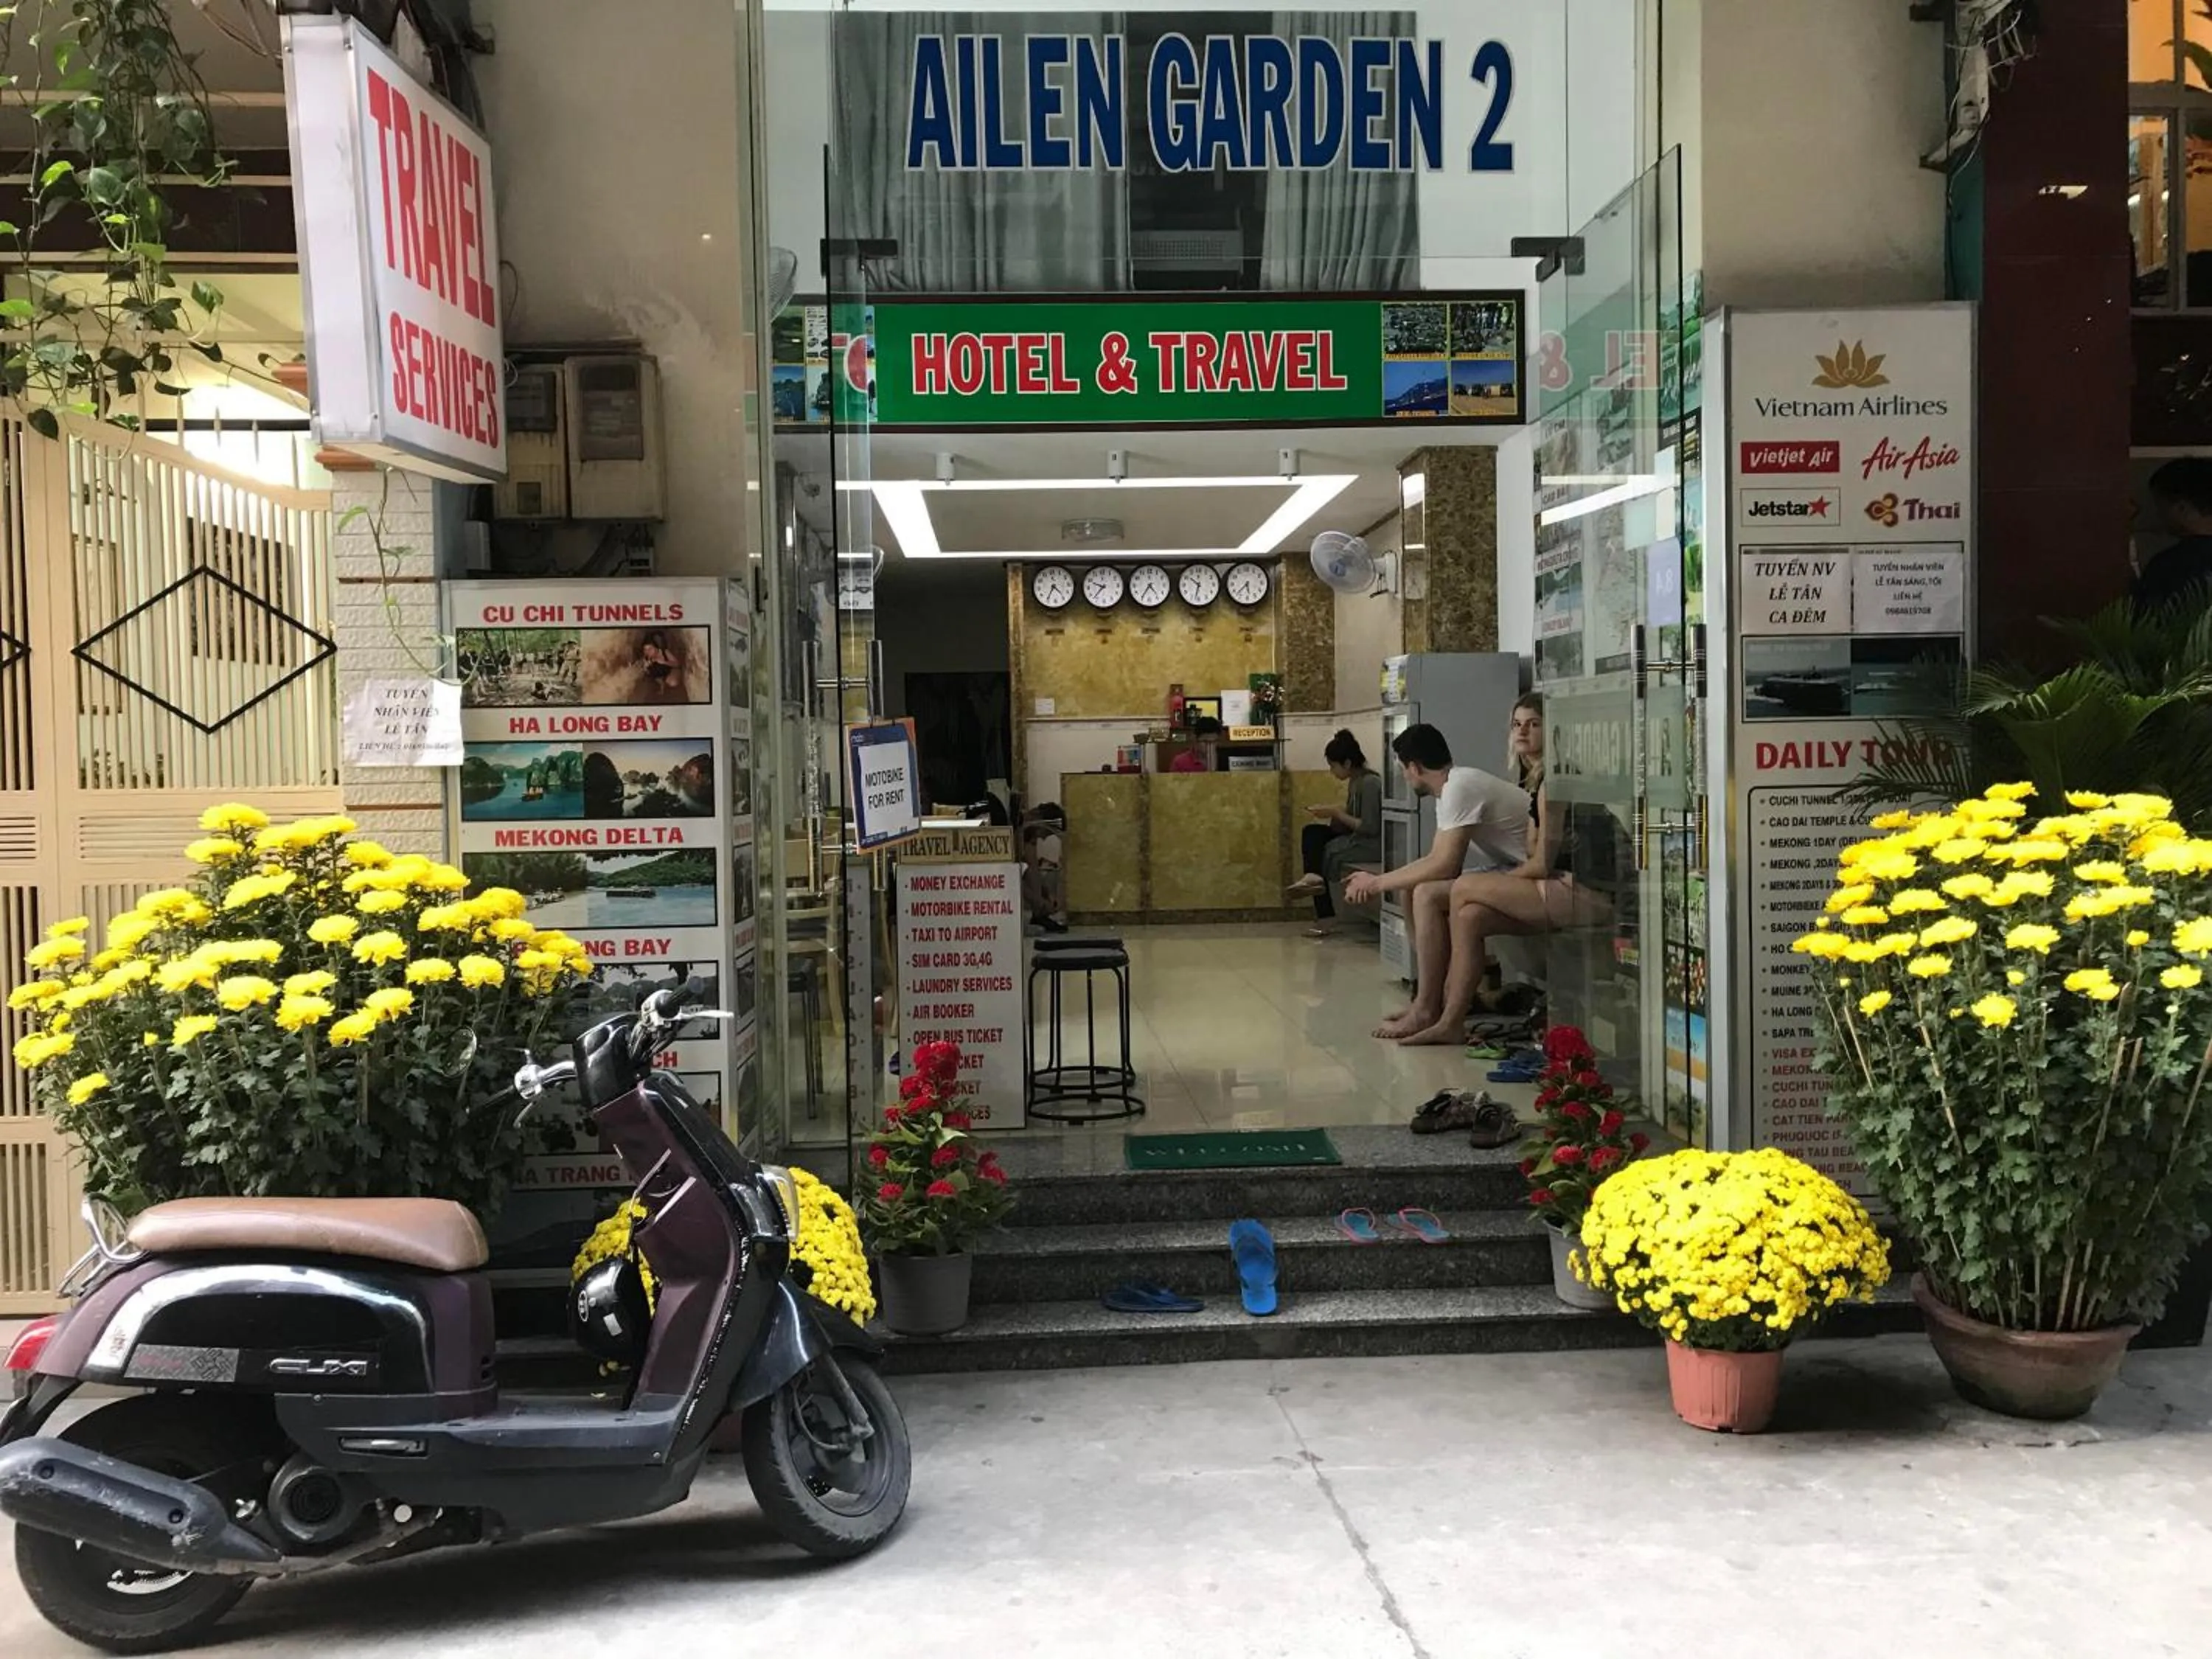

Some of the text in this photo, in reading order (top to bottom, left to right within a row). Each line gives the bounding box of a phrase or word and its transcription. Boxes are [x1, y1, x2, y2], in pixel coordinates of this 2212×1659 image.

[908, 33, 1514, 174] AILEN GARDEN 2
[367, 66, 495, 330] TRAVEL
[911, 329, 1348, 394] HOTEL & TRAVEL
[389, 310, 498, 449] SERVICES
[1754, 394, 1948, 417] Vietnam Airlines
[1807, 447, 1834, 467] Air
[1748, 500, 1810, 518] Jetstar
[1902, 498, 1961, 521] Thai
[1812, 562, 1837, 577] NV
[482, 603, 684, 623] CU CHI TUNNELS
[1769, 610, 1787, 624] CA
[509, 714, 664, 734] HA LONG BAY
[1755, 740, 1854, 770] DAILY
[868, 788, 905, 810] FOR RENT
[1769, 794, 1799, 806] CUCHI
[1769, 816, 1790, 827] CAO
[1792, 815, 1808, 827] DAI
[1810, 815, 1847, 827] TEMPLE
[495, 827, 684, 847] MEKONG DELTA
[902, 835, 951, 857] TRAVEL
[960, 834, 1010, 855] AGENCY
[1769, 838, 1811, 849] MEKONG
[1769, 859, 1811, 870] MEKONG
[910, 873, 1006, 891] MONEY EXCHANGE
[911, 899, 1014, 917] MOTORBIKE RENTAL
[911, 925, 998, 943] TAXI TO AIRPORT
[1770, 922, 1807, 933] SAIGON
[625, 938, 672, 956] BAY
[1770, 942, 1786, 954] HO
[911, 953, 931, 968] SIM
[932, 953, 961, 967] CARD
[1770, 964, 1810, 975] MONKEY
[912, 976, 1013, 994] LAUNDRY SERVICES
[912, 1003, 975, 1020] AIR BOOKER
[1771, 1006, 1785, 1018] HA
[1787, 1006, 1813, 1017] LONG
[913, 1027, 1004, 1045] OPEN BUS TICKET
[1771, 1048, 1798, 1059] VISA
[1772, 1081, 1809, 1093] CUCHI
[1771, 1098, 1797, 1109] CAO
[1800, 1097, 1820, 1108] DAI
[1771, 1115, 1794, 1126] CAT
[1807, 1147, 1829, 1158] TAU
[545, 1164, 621, 1183] TRANG
